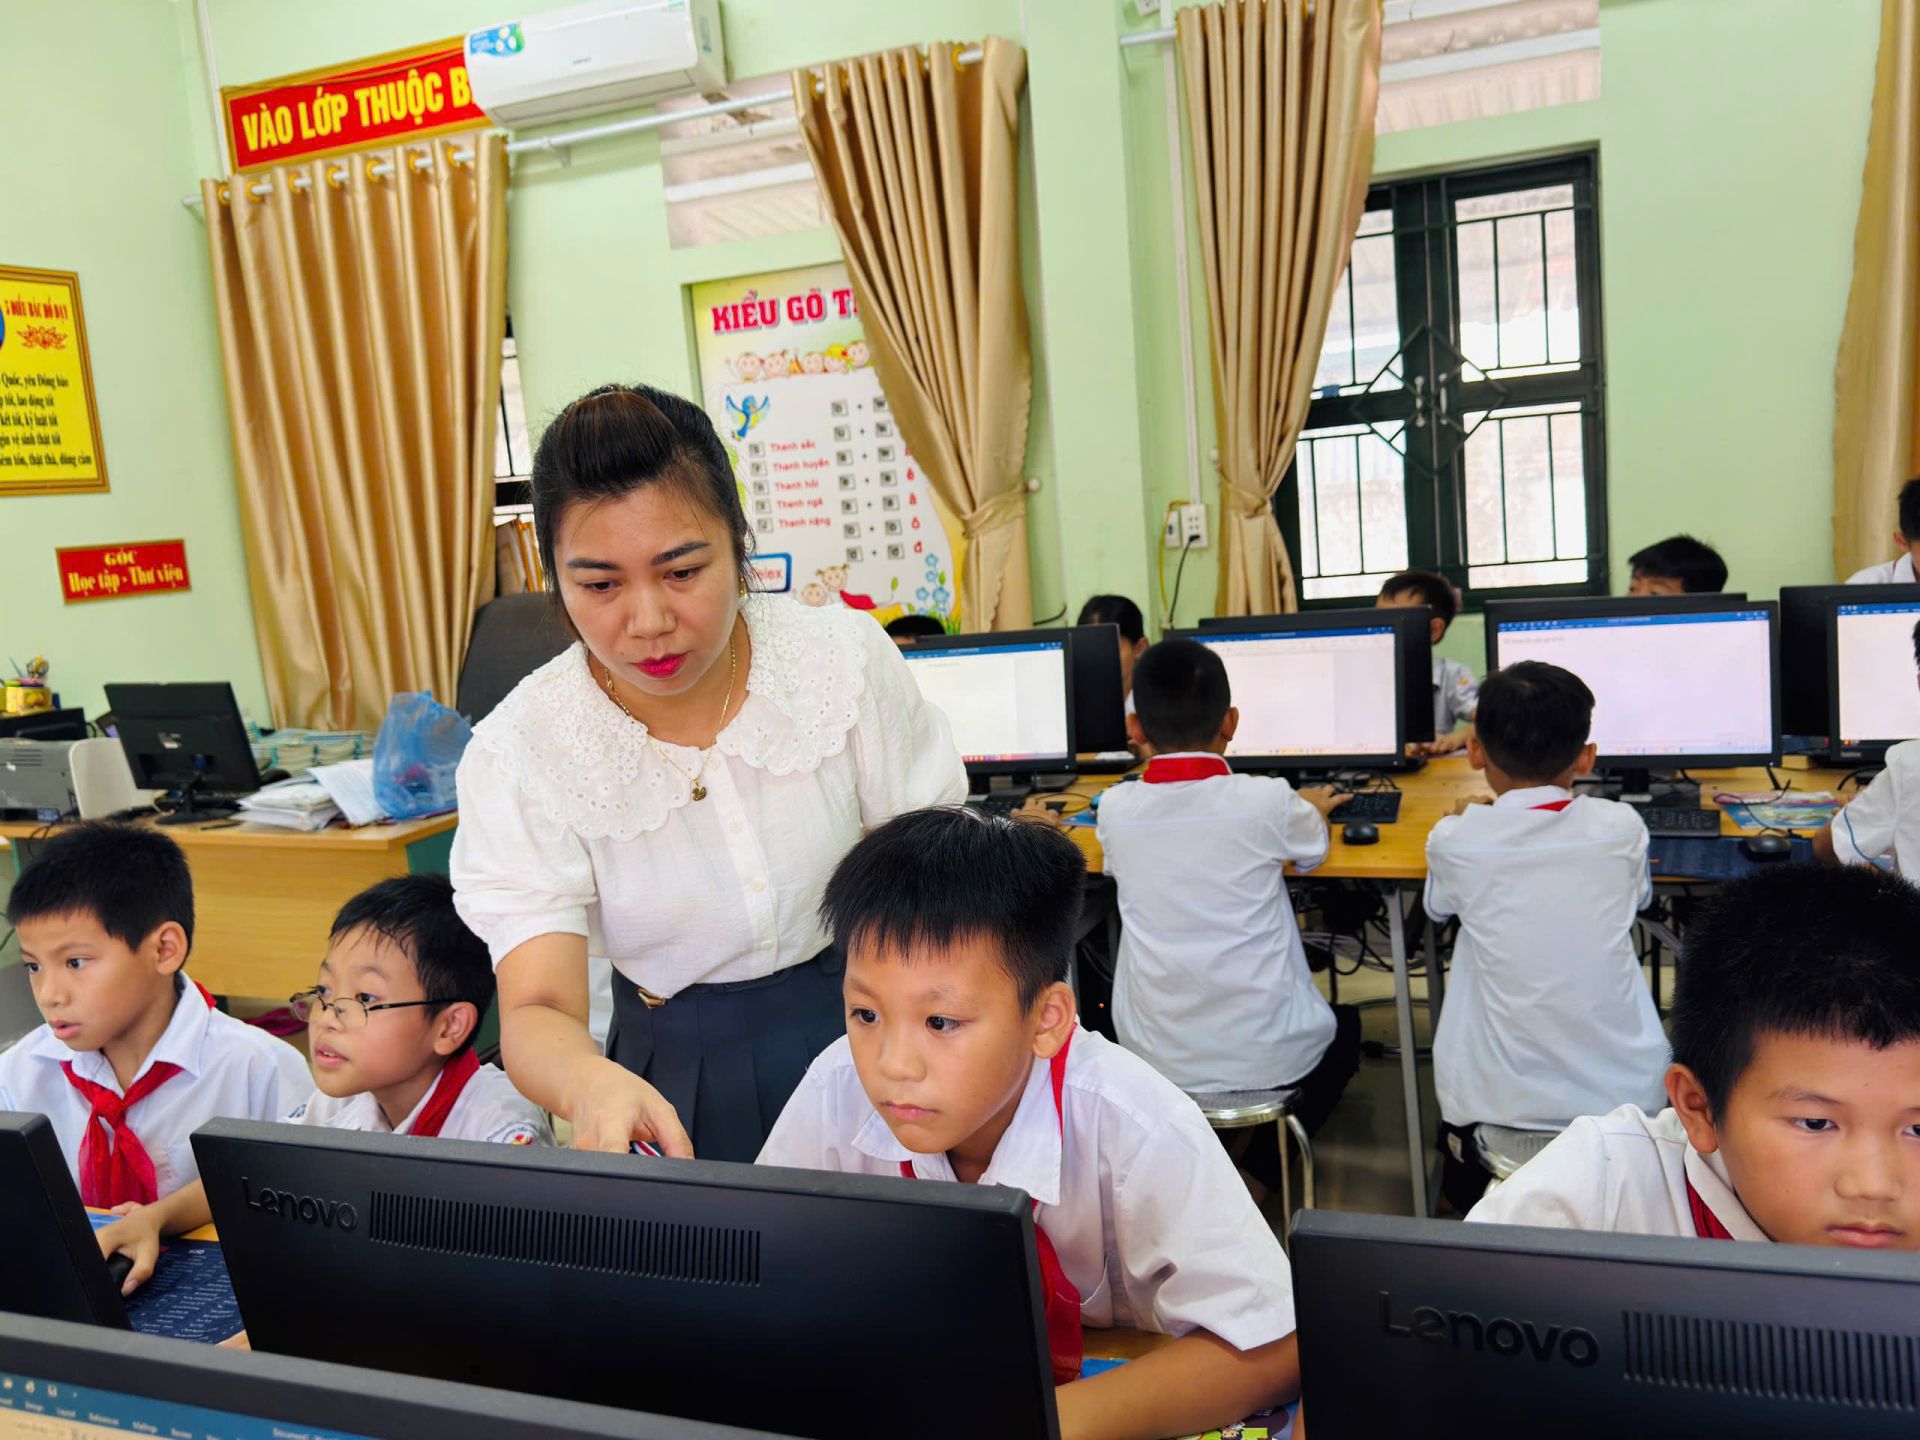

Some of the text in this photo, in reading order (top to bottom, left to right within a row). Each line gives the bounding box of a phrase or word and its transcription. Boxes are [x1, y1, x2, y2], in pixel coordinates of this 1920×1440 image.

[242, 66, 473, 152] VÀO LỚP THUỘC B
[711, 290, 780, 333] KIỂU
[832, 287, 857, 317] T
[770, 442, 799, 452] Thanh
[800, 438, 817, 450] sắc
[773, 461, 801, 471] Thanh
[802, 457, 831, 471] huyền
[775, 481, 803, 491] Thanh
[776, 500, 805, 510] Thanh
[778, 518, 807, 528] Thanh
[809, 517, 832, 529] nặng
[68, 571, 96, 597] Học
[98, 568, 120, 594] tập
[128, 565, 155, 587] Thư
[157, 563, 184, 589] viện
[241, 1176, 358, 1232] Lenovo
[1379, 1289, 1600, 1369] Lenovo
